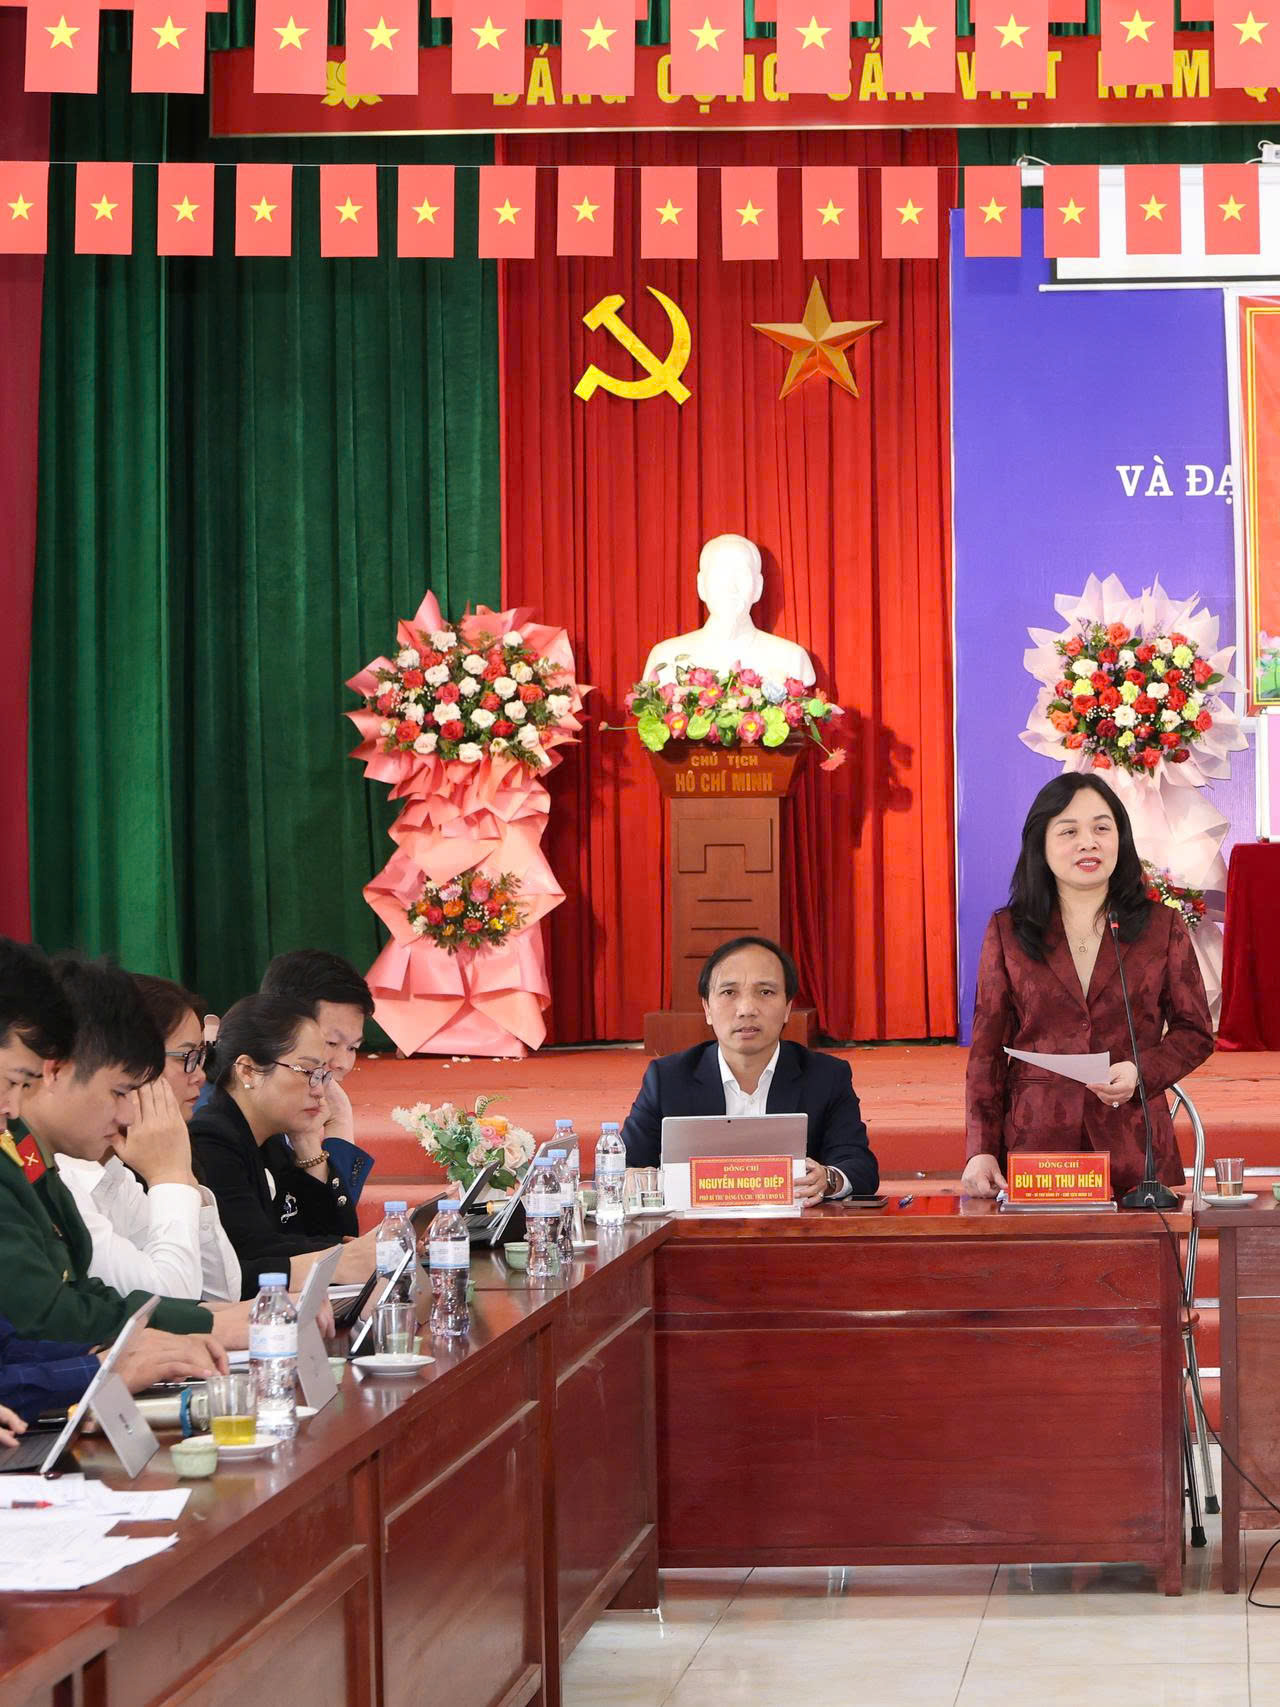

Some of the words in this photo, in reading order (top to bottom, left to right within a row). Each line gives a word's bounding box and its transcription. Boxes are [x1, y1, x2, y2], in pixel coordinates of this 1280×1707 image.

[1115, 455, 1174, 497] VÀ
[1184, 464, 1234, 505] ĐẠ
[726, 755, 759, 769] TỊCH
[700, 769, 727, 792] CHÍ
[731, 772, 773, 792] MINH
[698, 1174, 735, 1190] NGUYỄN
[737, 1176, 761, 1190] NGỌC
[1015, 1171, 1033, 1188] BÙI
[1035, 1174, 1052, 1190] THỊ
[1055, 1174, 1075, 1188] THU
